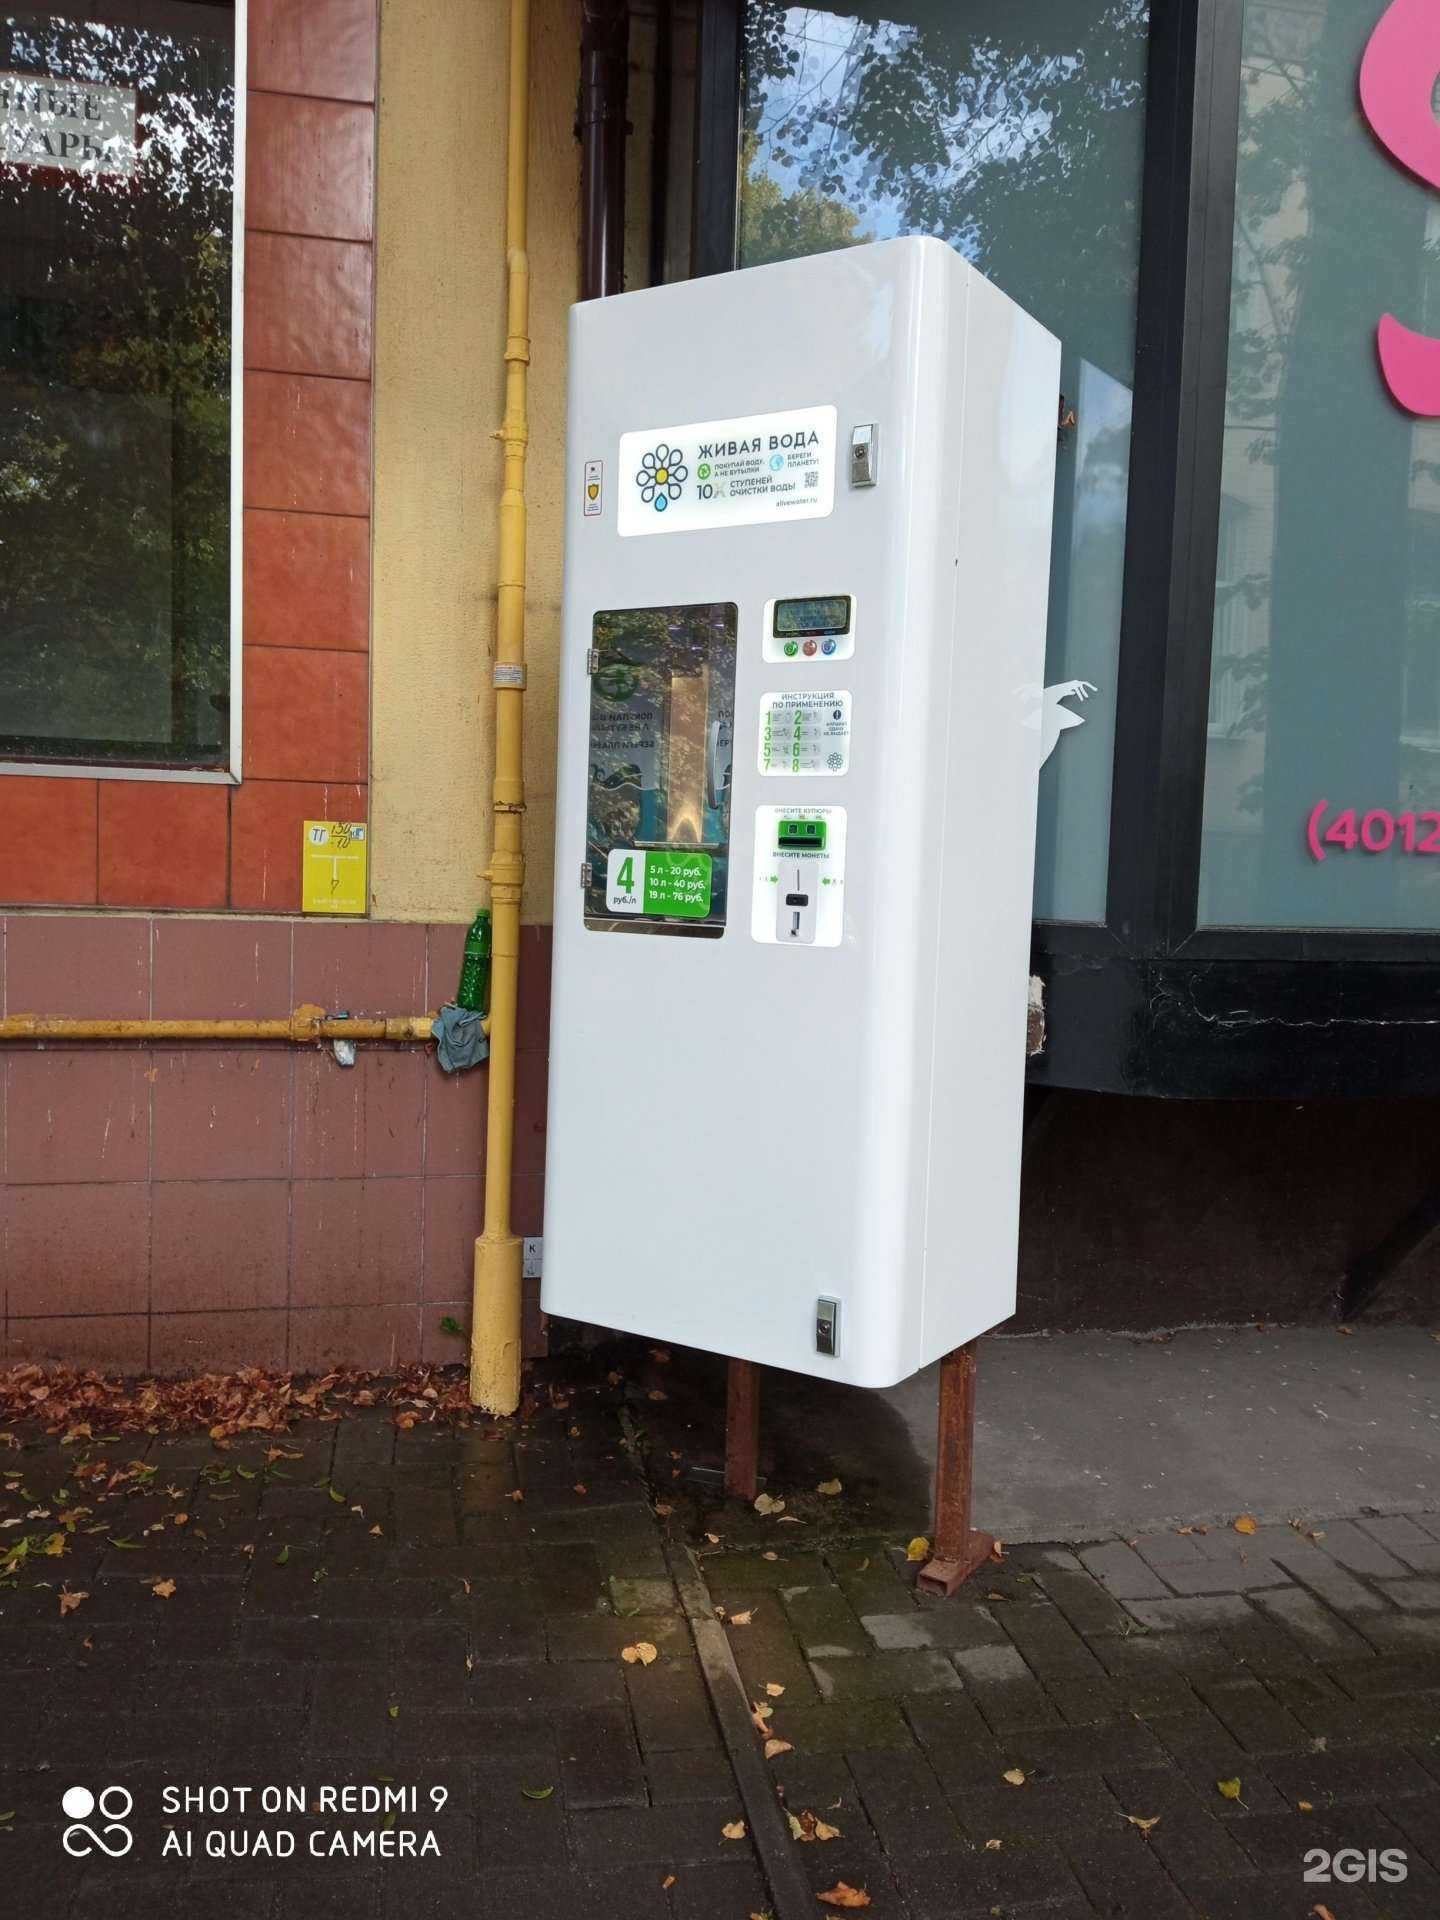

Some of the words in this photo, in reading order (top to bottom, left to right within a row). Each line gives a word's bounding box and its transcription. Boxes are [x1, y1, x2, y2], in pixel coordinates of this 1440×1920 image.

[697, 438, 762, 459] ЖИВАЯ
[769, 430, 819, 450] ВОДА
[729, 467, 760, 475] БУТЫЛКИ
[730, 475, 772, 488] СТУПЕНЕЙ
[730, 485, 768, 496] ОЧИСТКИ
[770, 482, 796, 493] ВОДЫ
[782, 692, 834, 700] ИНСТРУКЦИЯ
[786, 700, 843, 708] ПРИМЕНЕНИЮ
[766, 711, 771, 725] 1
[794, 710, 802, 724] 2
[764, 727, 771, 741] 3
[794, 726, 801, 741] 4
[764, 743, 771, 757] 5
[793, 743, 800, 757] 6
[764, 759, 770, 772] 7
[793, 759, 799, 772] 8
[617, 857, 635, 894] 4
[650, 866, 655, 874] 5
[670, 867, 681, 875] 20
[684, 867, 701, 878] руб.
[650, 878, 658, 886] 10
[674, 879, 685, 888] 40
[687, 880, 705, 890] руб.
[613, 895, 637, 905] руб./л
[649, 890, 658, 898] 19
[673, 892, 683, 900] 76
[685, 893, 703, 903] руб.
